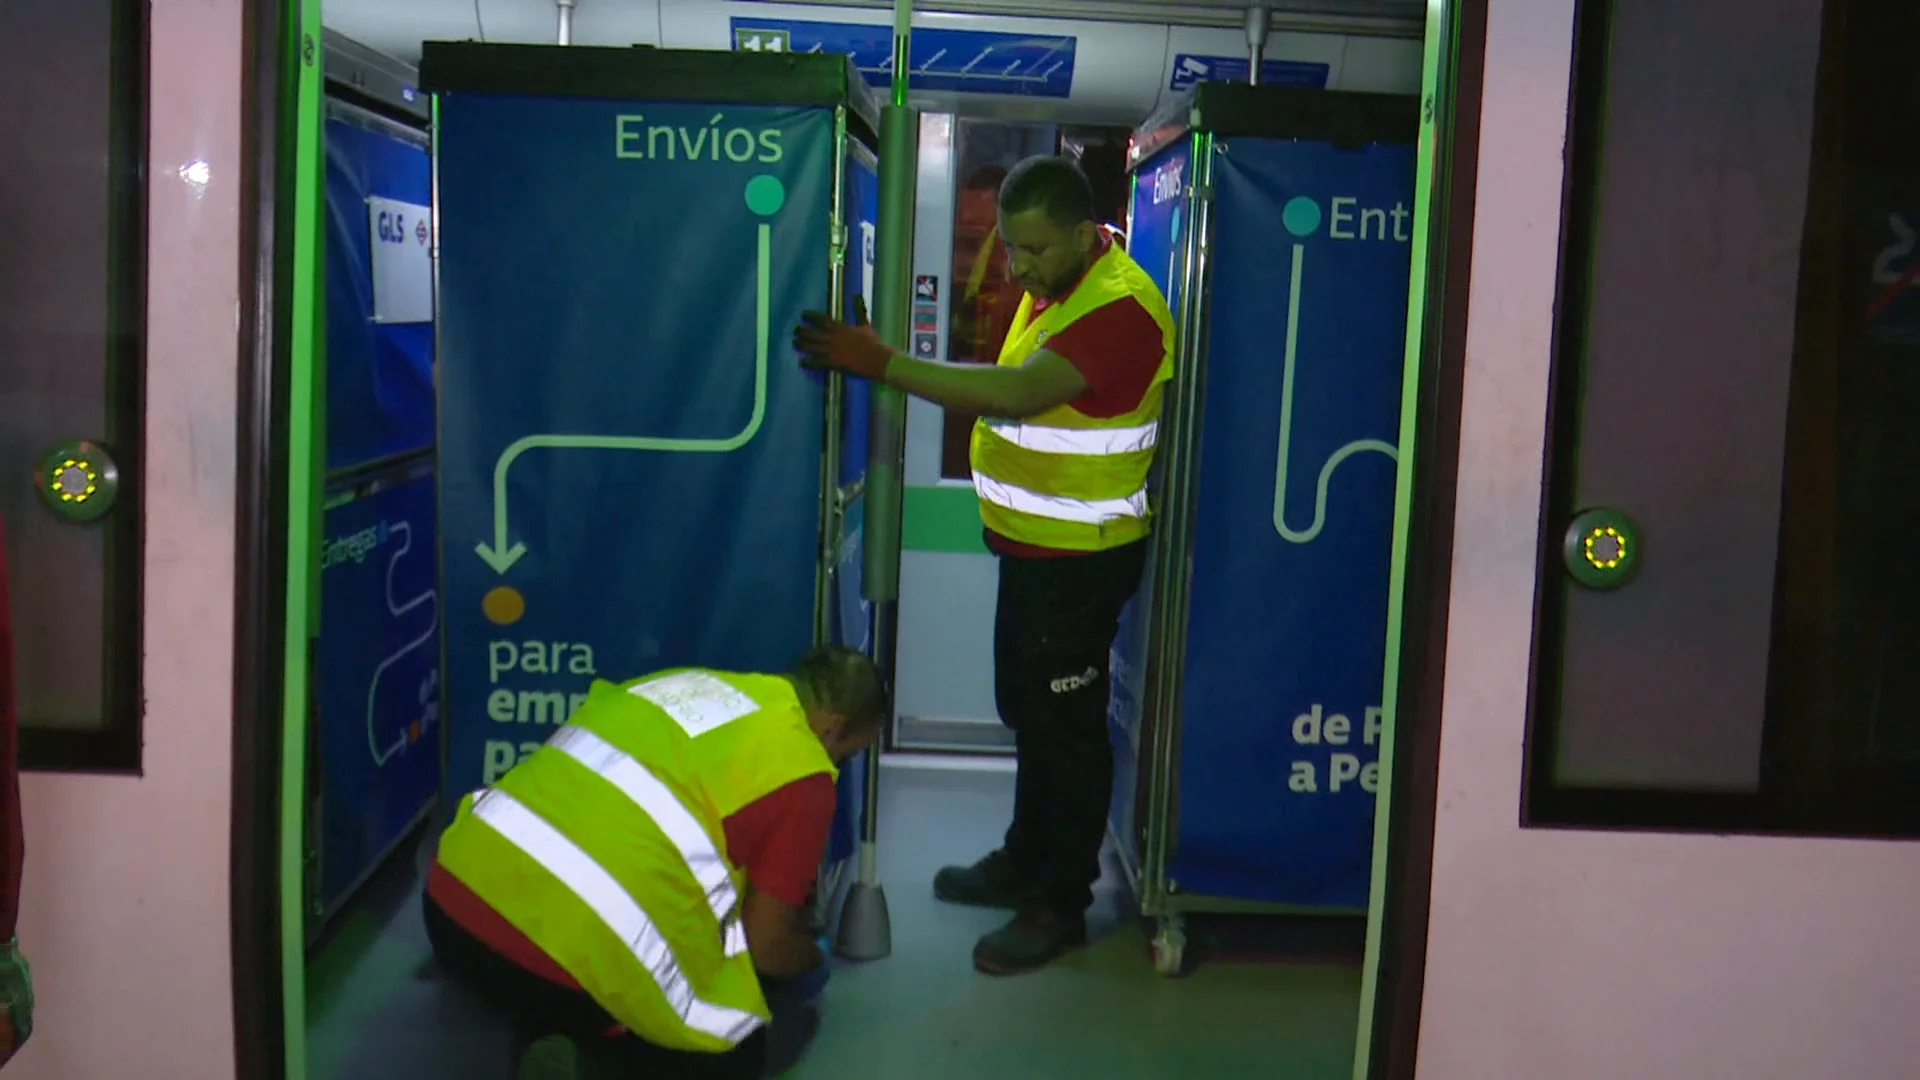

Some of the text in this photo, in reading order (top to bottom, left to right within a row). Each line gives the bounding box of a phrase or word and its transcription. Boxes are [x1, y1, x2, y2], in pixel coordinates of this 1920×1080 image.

[615, 112, 783, 163] Envíos
[378, 211, 404, 244] GLS
[488, 640, 597, 683] para
[1292, 703, 1351, 744] de
[1288, 753, 1379, 793] a Pe
